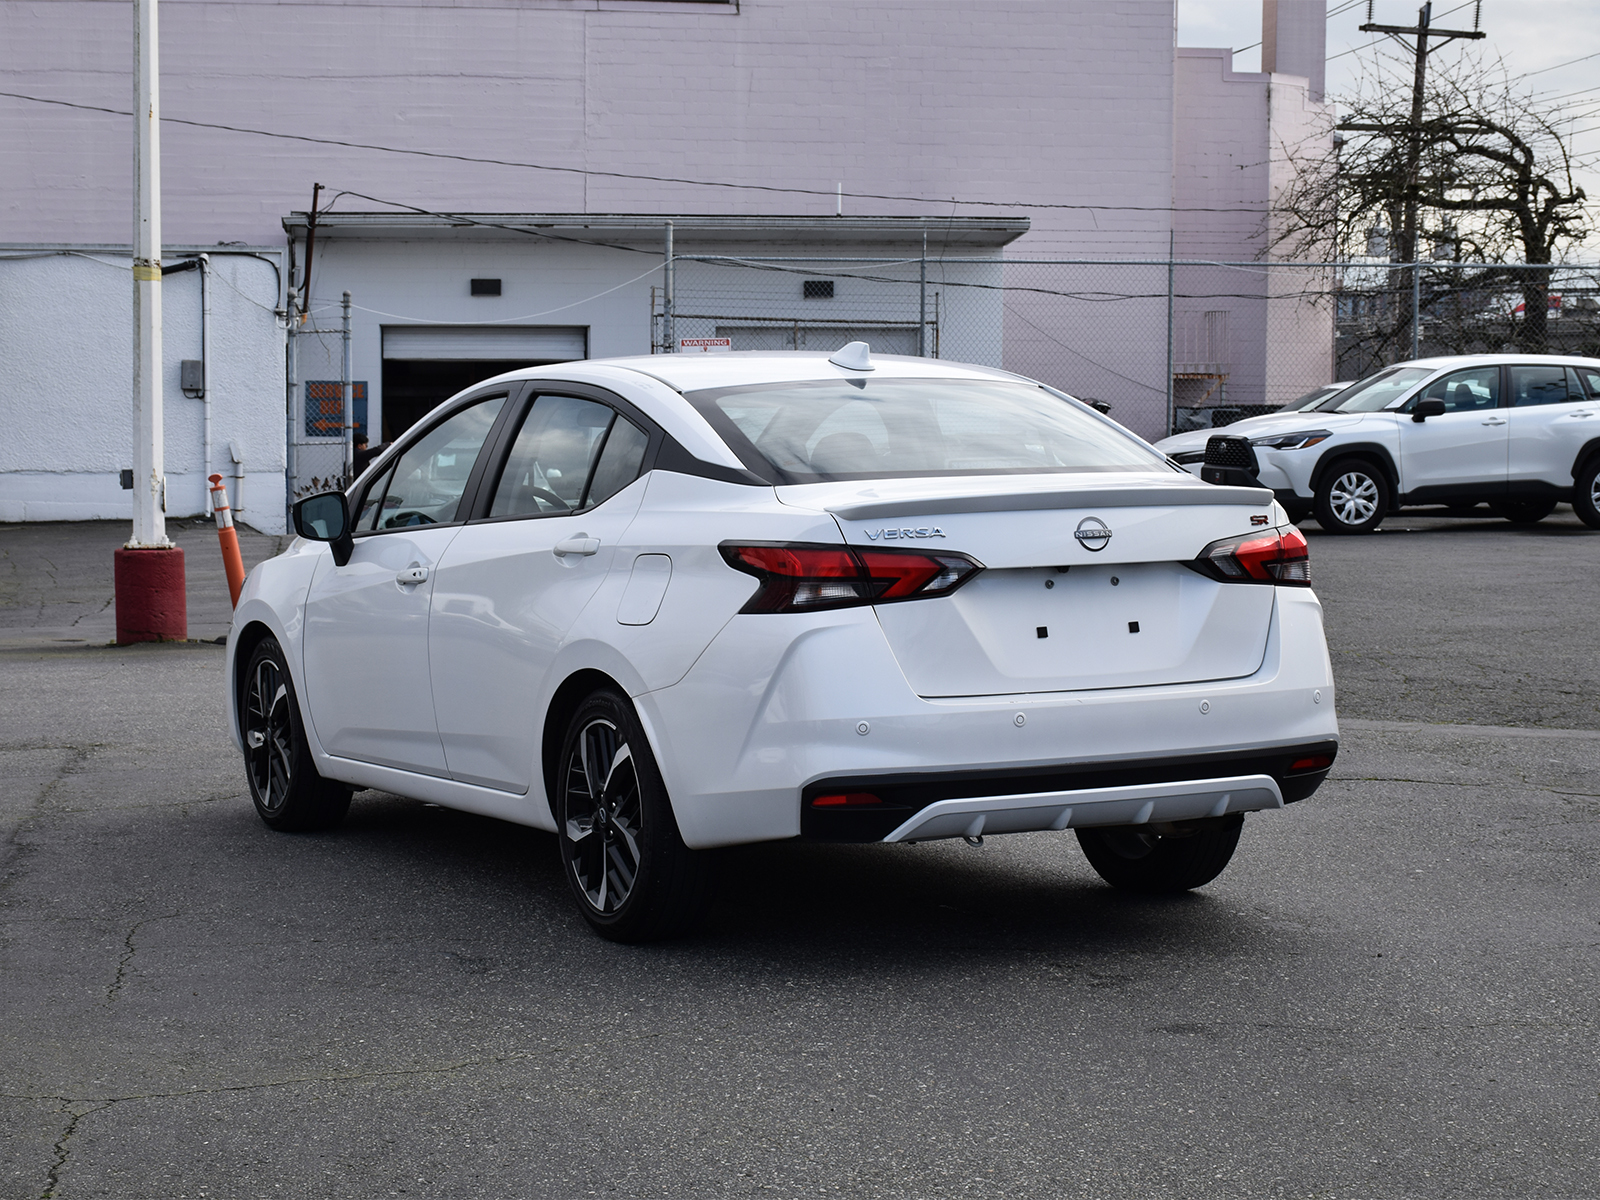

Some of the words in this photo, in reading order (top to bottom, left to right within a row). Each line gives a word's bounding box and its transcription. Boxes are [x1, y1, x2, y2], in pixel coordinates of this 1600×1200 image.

[309, 383, 364, 398] SERVCE
[1250, 514, 1269, 526] SR
[864, 526, 947, 540] VERSA
[1075, 530, 1112, 538] NISSAN
